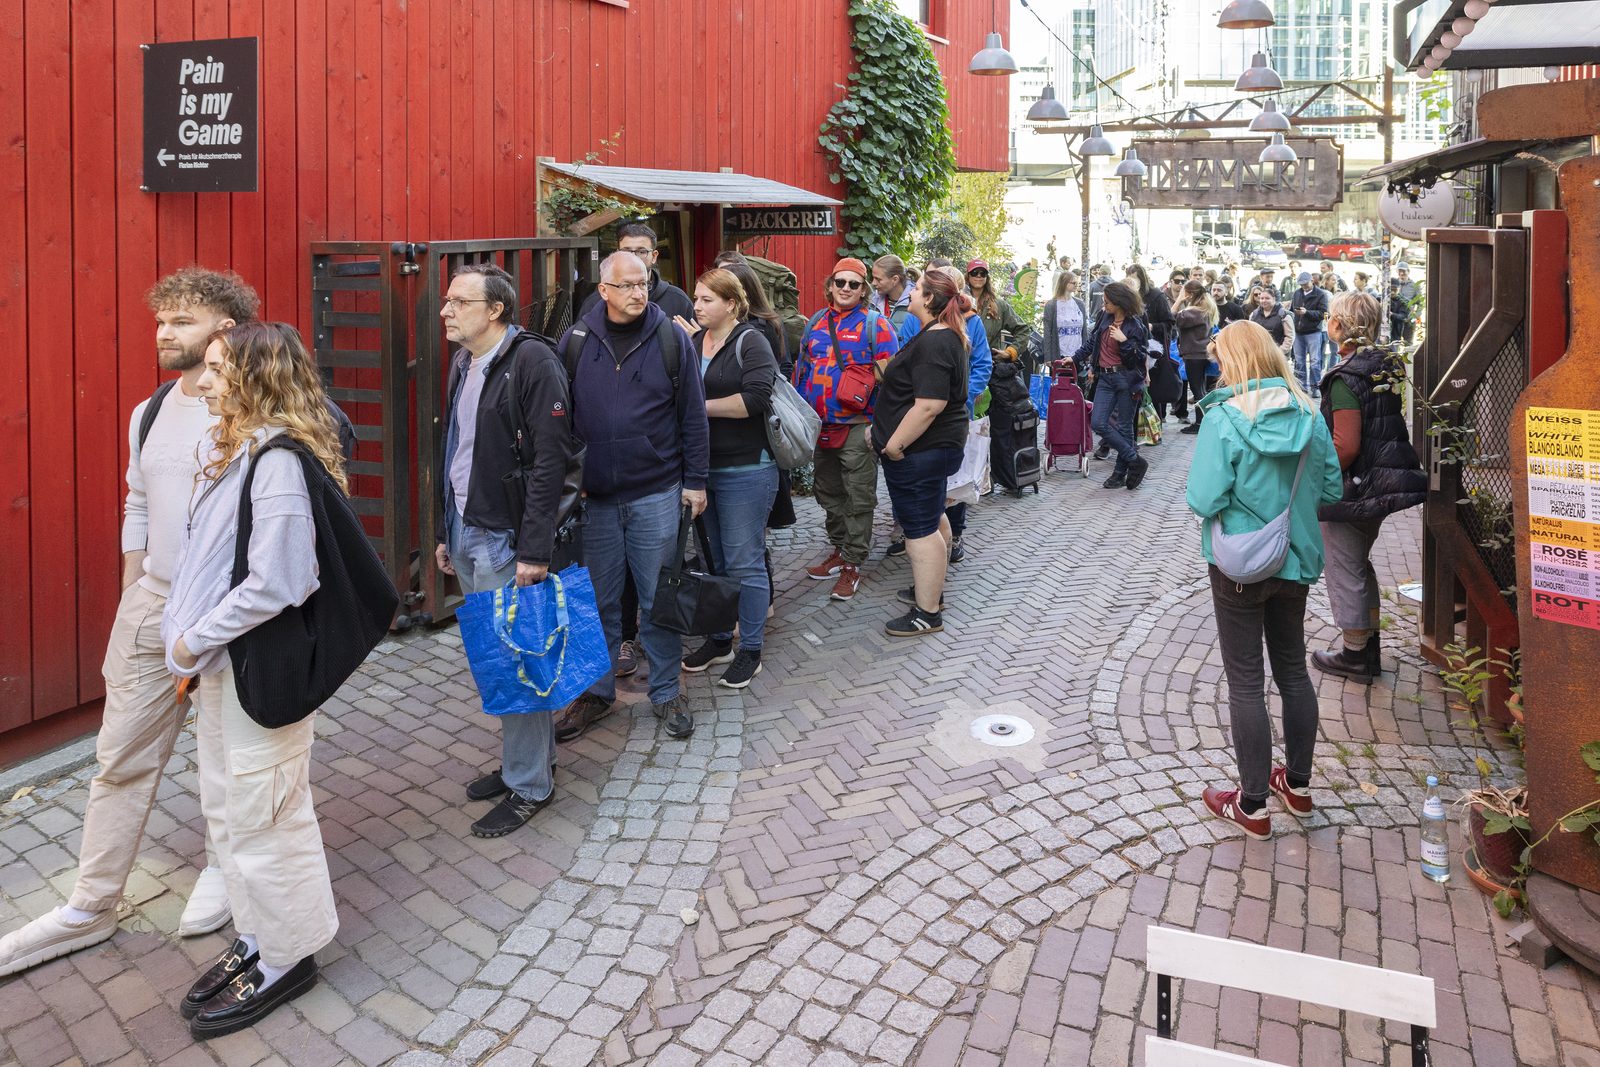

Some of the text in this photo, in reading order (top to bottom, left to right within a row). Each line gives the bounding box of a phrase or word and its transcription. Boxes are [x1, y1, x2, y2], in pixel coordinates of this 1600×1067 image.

[179, 56, 224, 85] Pain
[179, 87, 233, 121] is my
[178, 119, 242, 146] Game
[1529, 415, 1582, 424] WEISS
[1529, 431, 1583, 442] WHITE
[1529, 441, 1584, 458] BLANCO BLANCO
[1531, 486, 1585, 496] SPARKLING
[1551, 506, 1587, 519] PRICKELND
[1532, 529, 1587, 543] NATURAL
[1534, 554, 1562, 564] PINK
[1542, 545, 1588, 562] ROSÉ
[1535, 580, 1566, 592] ALKOHOLFREI
[1536, 593, 1590, 611] ROT
